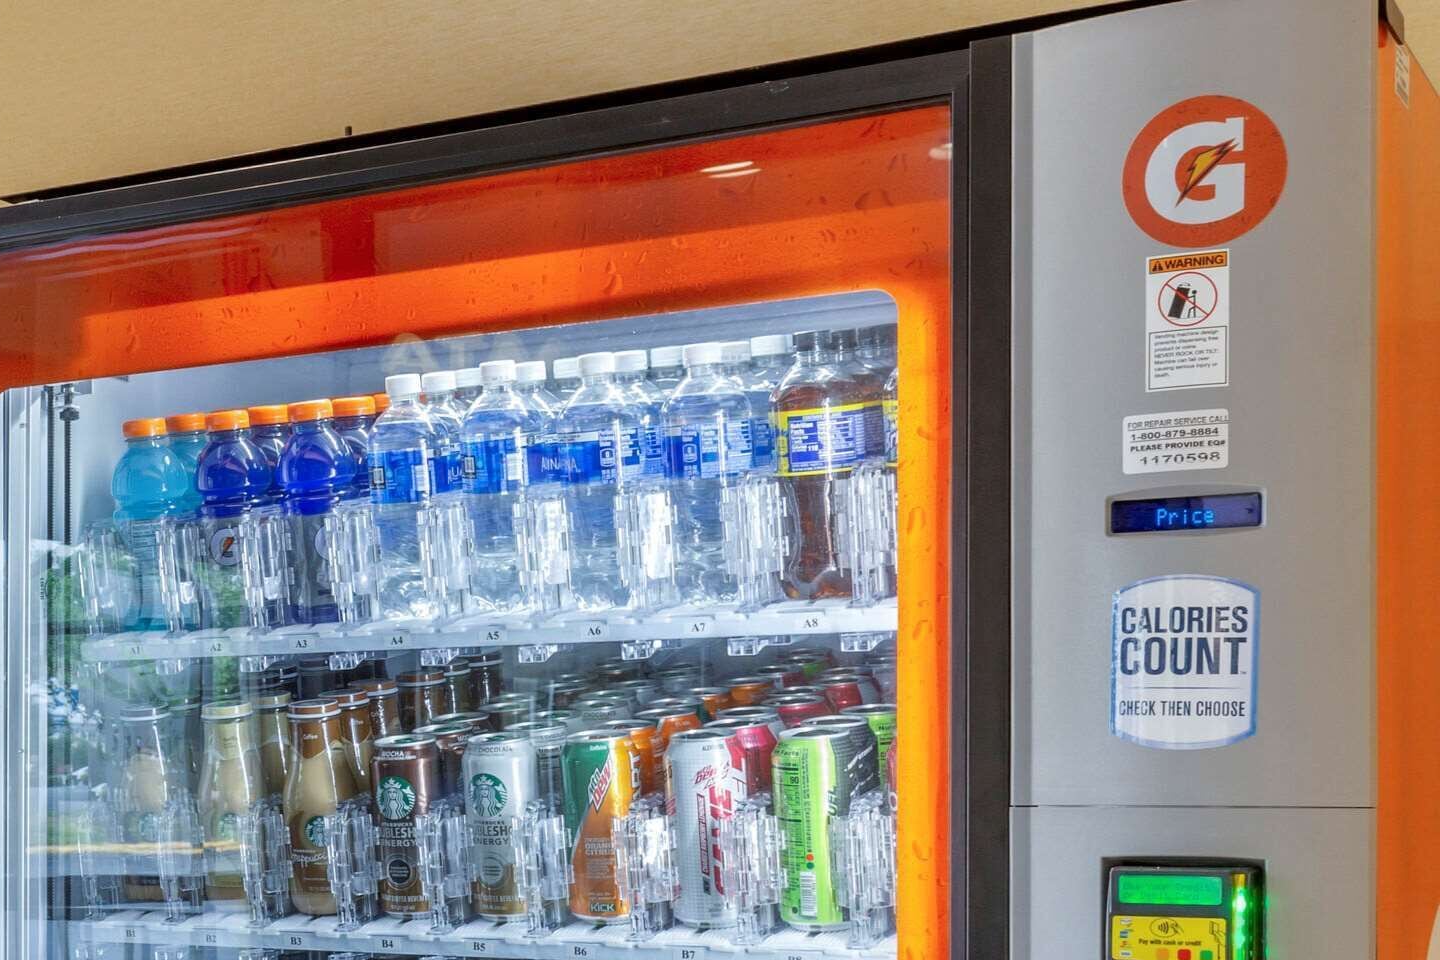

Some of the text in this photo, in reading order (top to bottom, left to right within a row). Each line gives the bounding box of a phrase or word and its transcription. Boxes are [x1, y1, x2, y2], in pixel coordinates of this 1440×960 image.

[1144, 117, 1245, 224] G
[1165, 255, 1224, 269] WARNING
[1144, 419, 1172, 427] REPAIR
[1174, 416, 1207, 425] SERVICE
[1131, 427, 1219, 441] 1-800-879-8884
[1130, 443, 1162, 452] PLEASE
[1165, 441, 1205, 449] PROVIDE
[1139, 452, 1221, 465] 1170598
[1156, 508, 1215, 526] Price
[803, 617, 818, 628] A8
[1121, 606, 1248, 633] CALORIES
[587, 626, 602, 637] A6
[691, 622, 705, 633] A7
[390, 636, 403, 646] A4
[486, 630, 500, 641] A5
[209, 642, 222, 652] A2
[295, 638, 307, 649] A3
[1120, 637, 1247, 675] COUNT
[1119, 701, 1246, 717] CHECK THEN CHOOSE
[790, 776, 799, 784] 90
[126, 929, 136, 938] B1
[290, 936, 302, 945] B3
[381, 939, 393, 949] B4
[1138, 938, 1148, 946] Pay
[473, 942, 485, 952] B5
[574, 946, 587, 956] B6
[682, 949, 695, 960] B7
